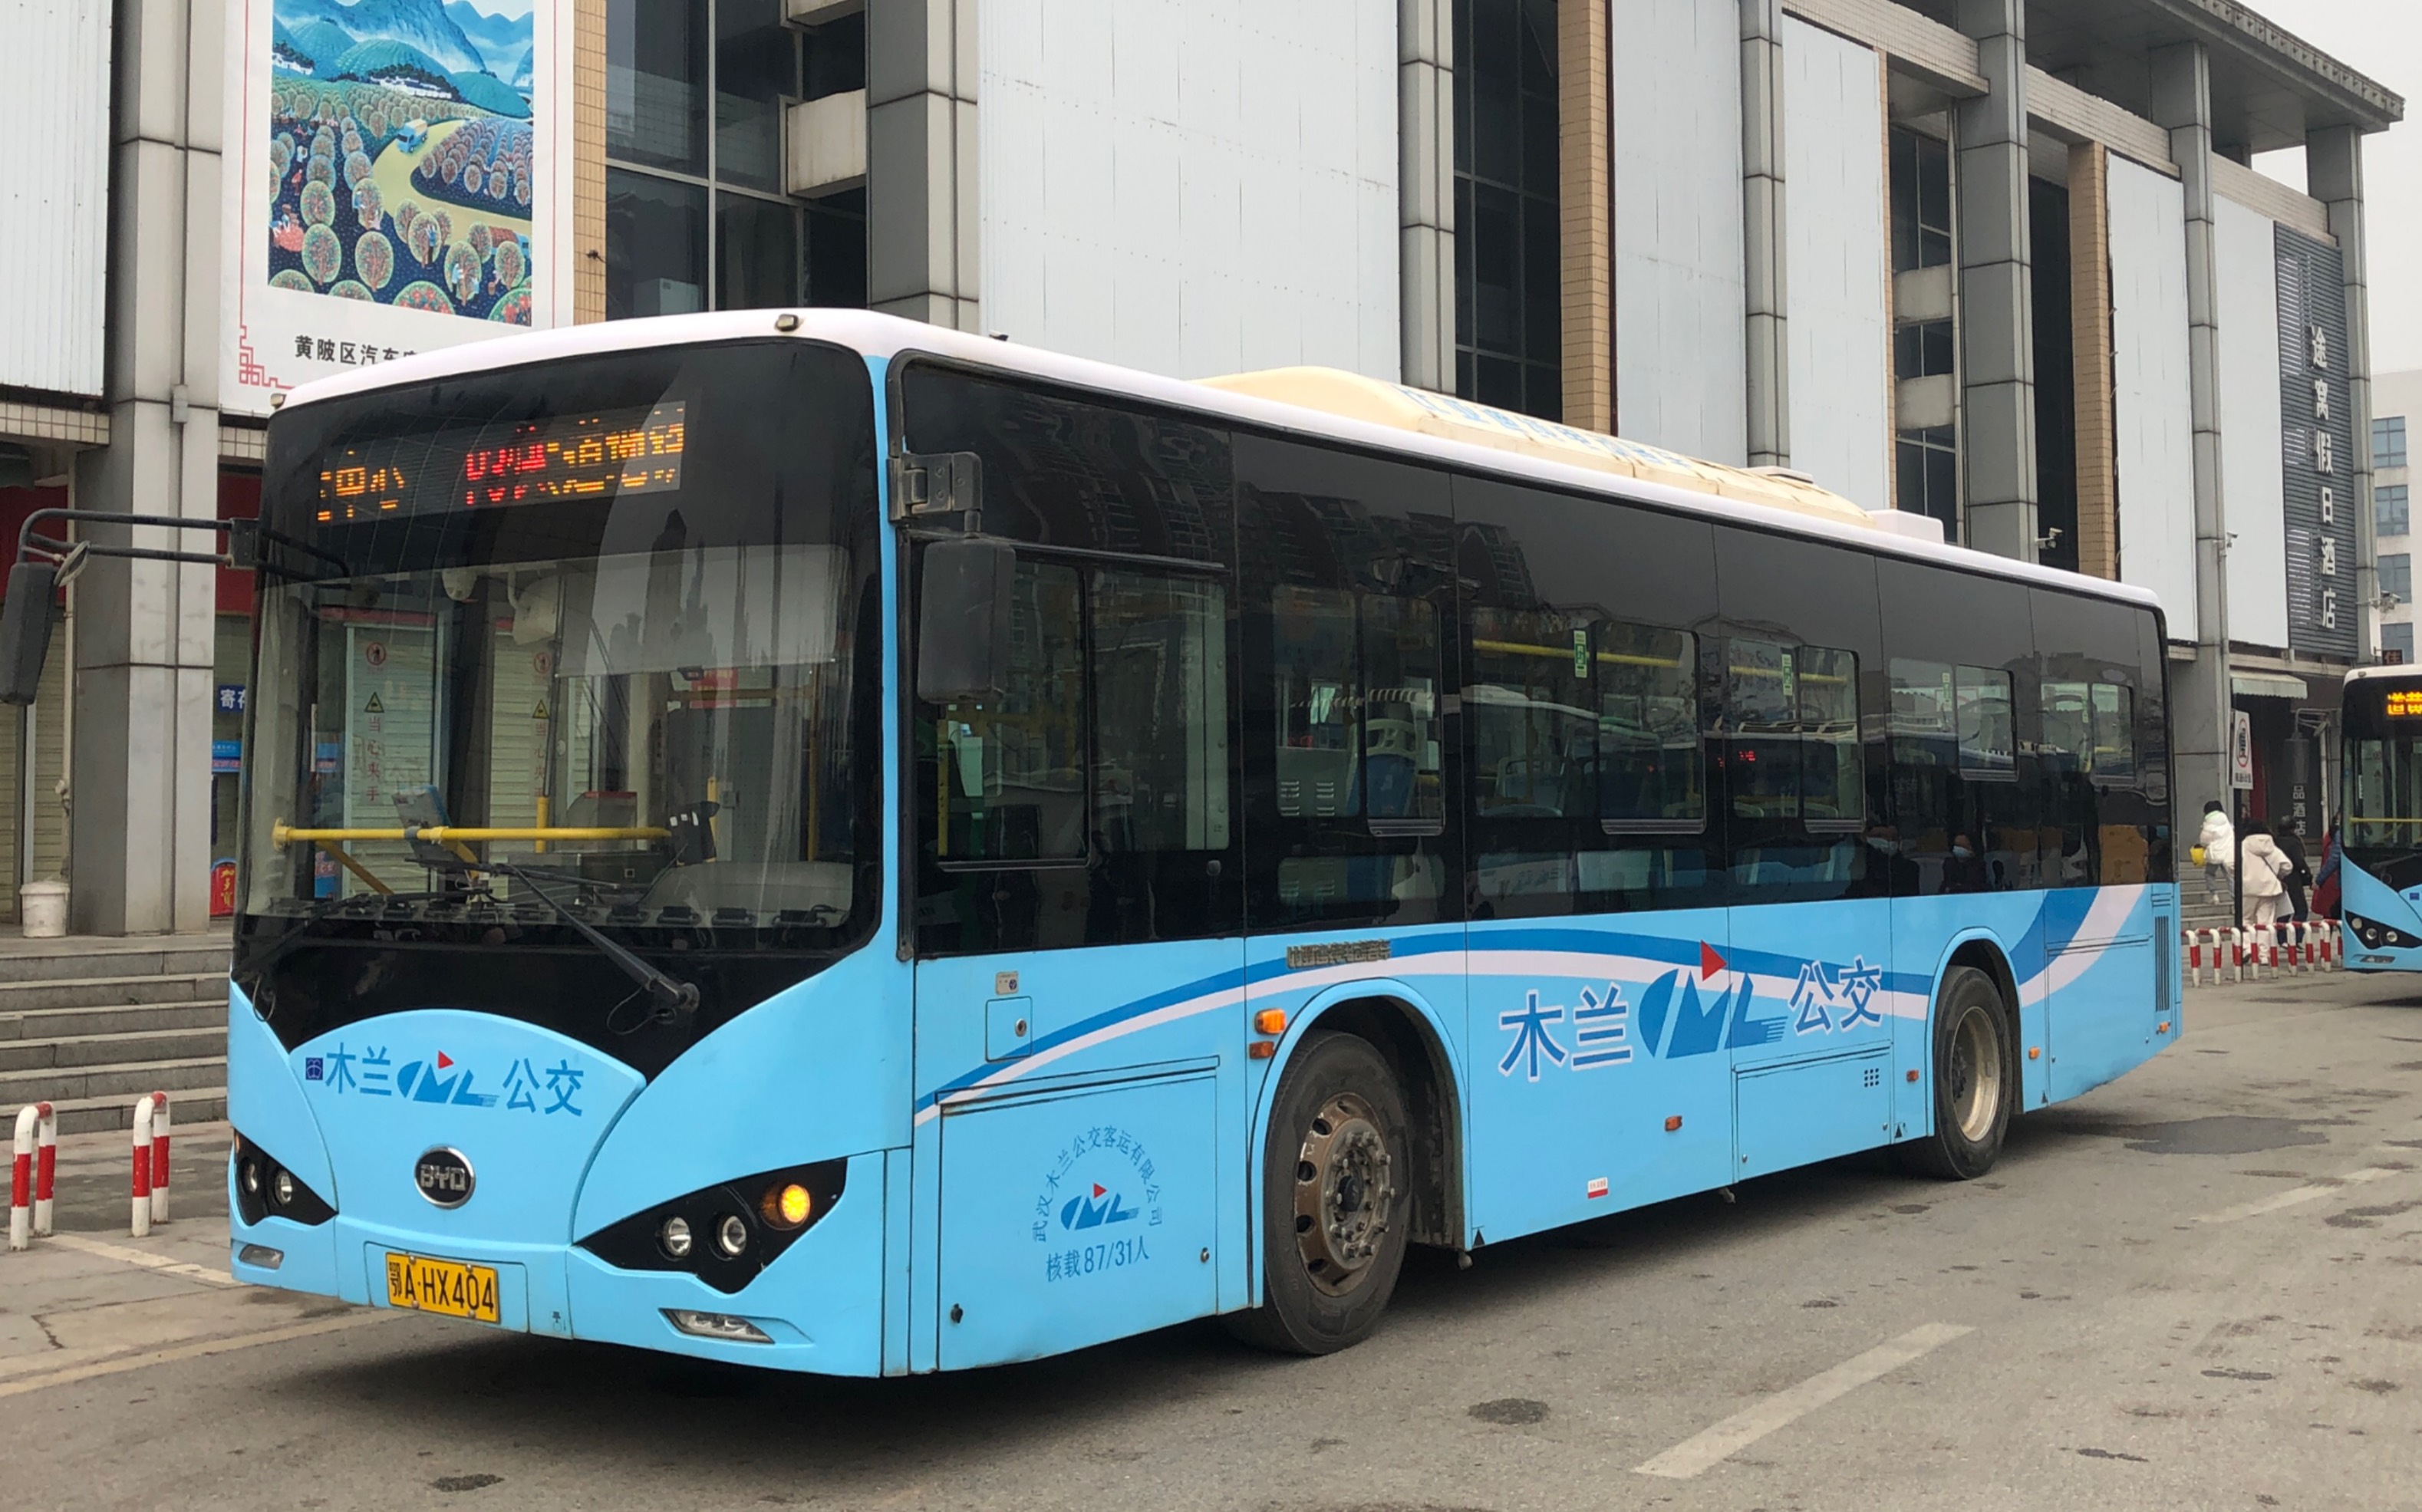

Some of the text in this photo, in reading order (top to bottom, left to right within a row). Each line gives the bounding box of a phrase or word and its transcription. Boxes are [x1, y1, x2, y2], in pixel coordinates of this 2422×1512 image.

[295, 334, 417, 366] 黄陂区汽车
[1788, 954, 1883, 1036] 公交
[1498, 983, 1633, 1082] 木兰
[325, 1041, 392, 1095] 木兰
[502, 1057, 585, 1117] 公交
[420, 1163, 466, 1191] BYD
[1032, 1125, 1162, 1243] 武汉木兰公交客运有限公司
